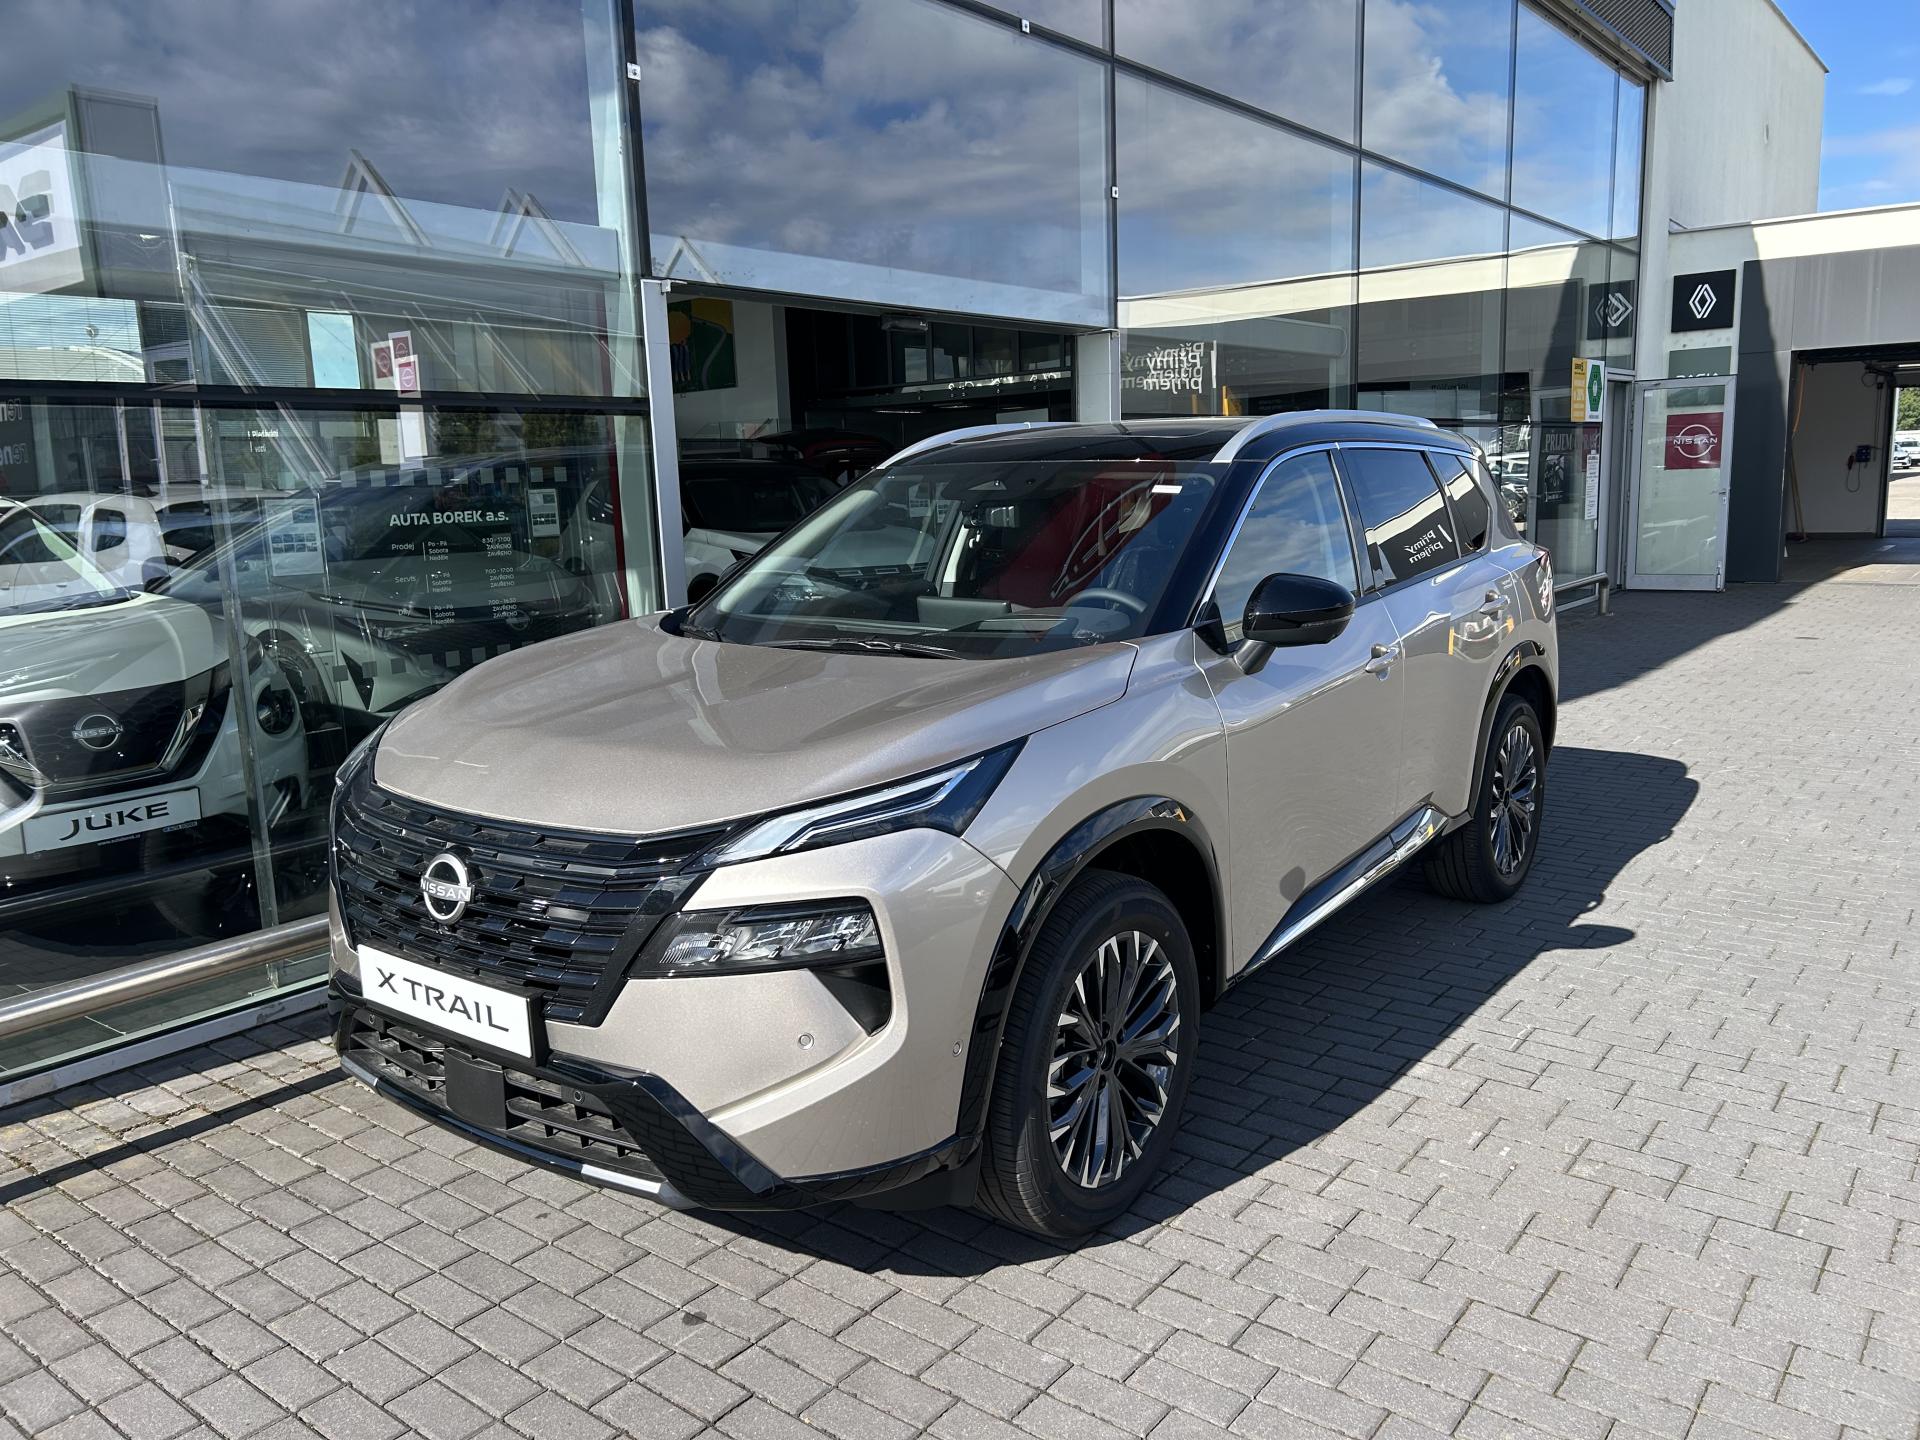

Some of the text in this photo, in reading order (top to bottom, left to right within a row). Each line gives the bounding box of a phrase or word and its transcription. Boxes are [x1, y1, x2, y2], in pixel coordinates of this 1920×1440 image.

[1673, 437, 1718, 445] NISSAN
[390, 510, 509, 527] AUTA BOREK a.s.
[391, 542, 415, 551] Prodej
[73, 724, 124, 739] NISSAN
[58, 801, 170, 841] JUKE
[420, 878, 471, 900] NISSAN
[376, 967, 510, 1033] X TRAIL
